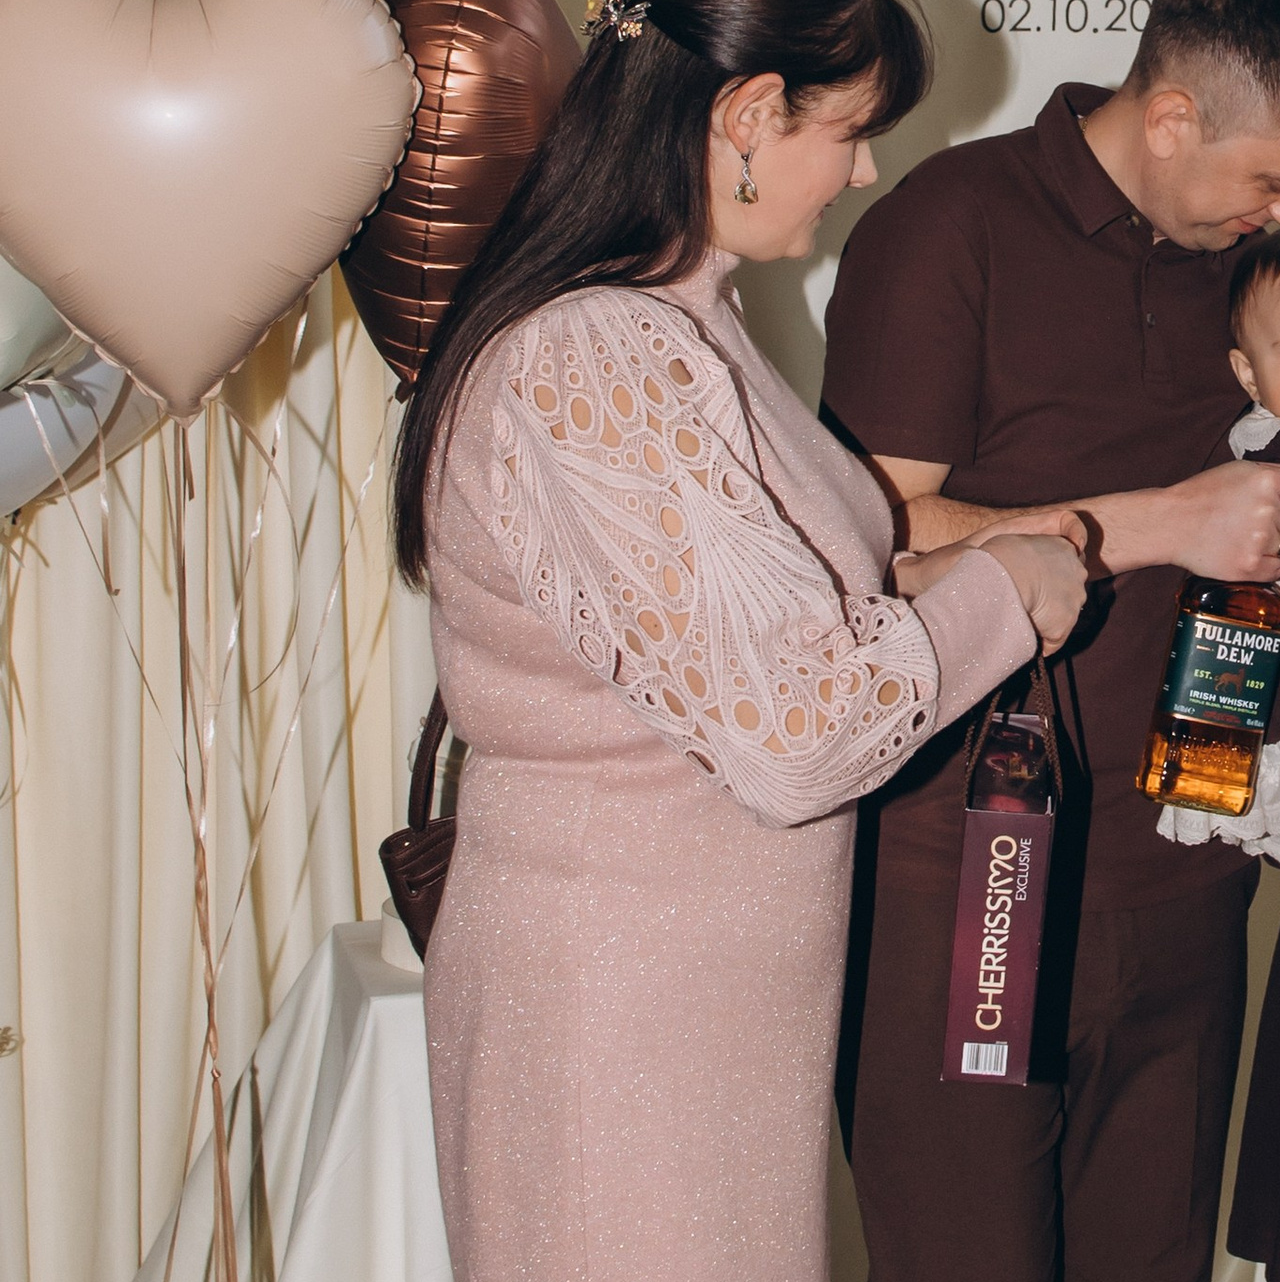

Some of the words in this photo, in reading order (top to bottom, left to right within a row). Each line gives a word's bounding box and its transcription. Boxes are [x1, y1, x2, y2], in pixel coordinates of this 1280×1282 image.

[1194, 621, 1280, 653] TULLAMORE
[1216, 644, 1254, 666] D.E.W.
[1193, 668, 1213, 680] EST.
[1245, 679, 1265, 690] 1829
[1189, 689, 1217, 702] IRISH
[1219, 696, 1260, 710] WHISKEY
[1015, 837, 1032, 901] EXCLUSIVE
